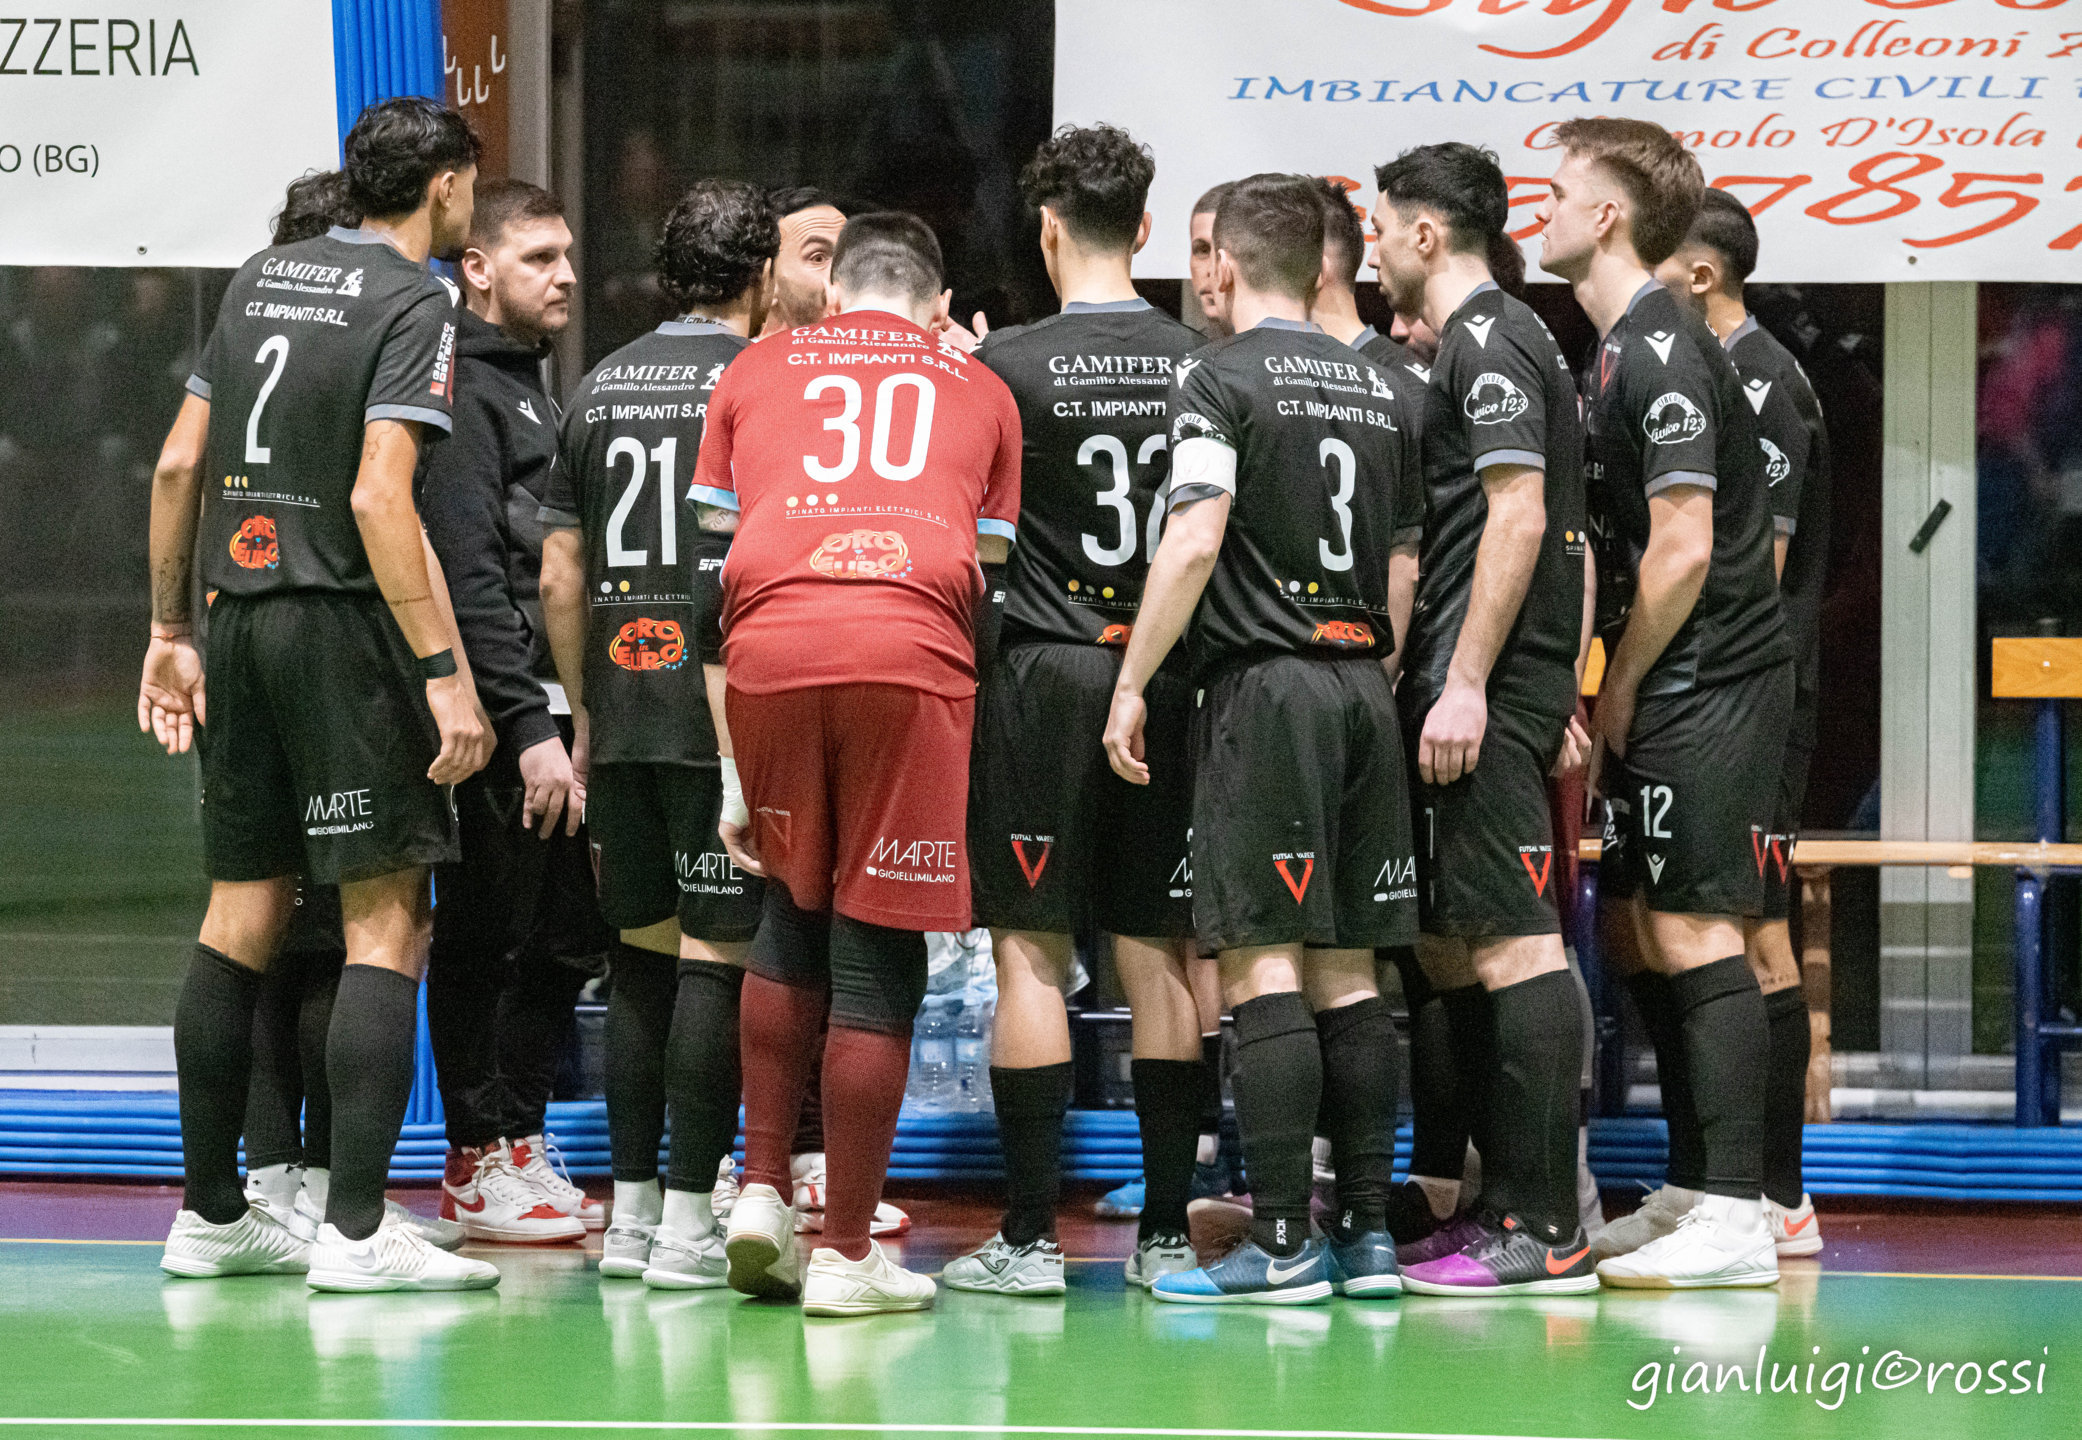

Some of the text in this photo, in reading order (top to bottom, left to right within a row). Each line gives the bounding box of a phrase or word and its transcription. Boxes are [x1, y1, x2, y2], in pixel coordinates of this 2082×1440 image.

[1651, 23, 1724, 61] di
[1745, 20, 2030, 59] Colleoni
[1227, 76, 1792, 102] IMBIANCATURE
[1814, 76, 2050, 100] CIVILI
[1820, 112, 2047, 147] D'Isola
[33, 143, 99, 177] (BG)
[261, 257, 343, 283] GAMIFER
[263, 302, 312, 321] IMPIANTI
[791, 325, 926, 343] GAMIFER
[787, 353, 820, 366] C.T.
[829, 353, 916, 366] IMPIANTI
[1048, 355, 1173, 374] GAMIFER
[1264, 356, 1362, 382] GAMIFER
[595, 365, 698, 383] GAMIFER
[601, 383, 640, 391] Gamillo
[641, 383, 695, 391] Alessandro
[1054, 376, 1171, 386] di Gamillo Alessand
[1273, 376, 1284, 386] di
[245, 335, 290, 463] 2
[1053, 401, 1167, 417] C.T. IMPIANTI
[1277, 400, 1304, 416] C.T.
[1305, 400, 1363, 423] IMPIANTI
[585, 405, 607, 423] C.T.
[612, 404, 678, 419] IMPIANTI
[803, 373, 936, 483] 30
[605, 436, 677, 568] 21
[830, 506, 872, 514] IMPIANTI
[1318, 437, 1356, 572] 3
[822, 529, 903, 553] ORO
[619, 617, 680, 643] ORO
[616, 643, 683, 670] EURO
[305, 789, 372, 821] MARTE
[1639, 784, 1673, 839] 12
[869, 836, 956, 867] MARTE
[674, 850, 743, 880] MARTE
[878, 868, 956, 883] GIOIELLIMILANO
